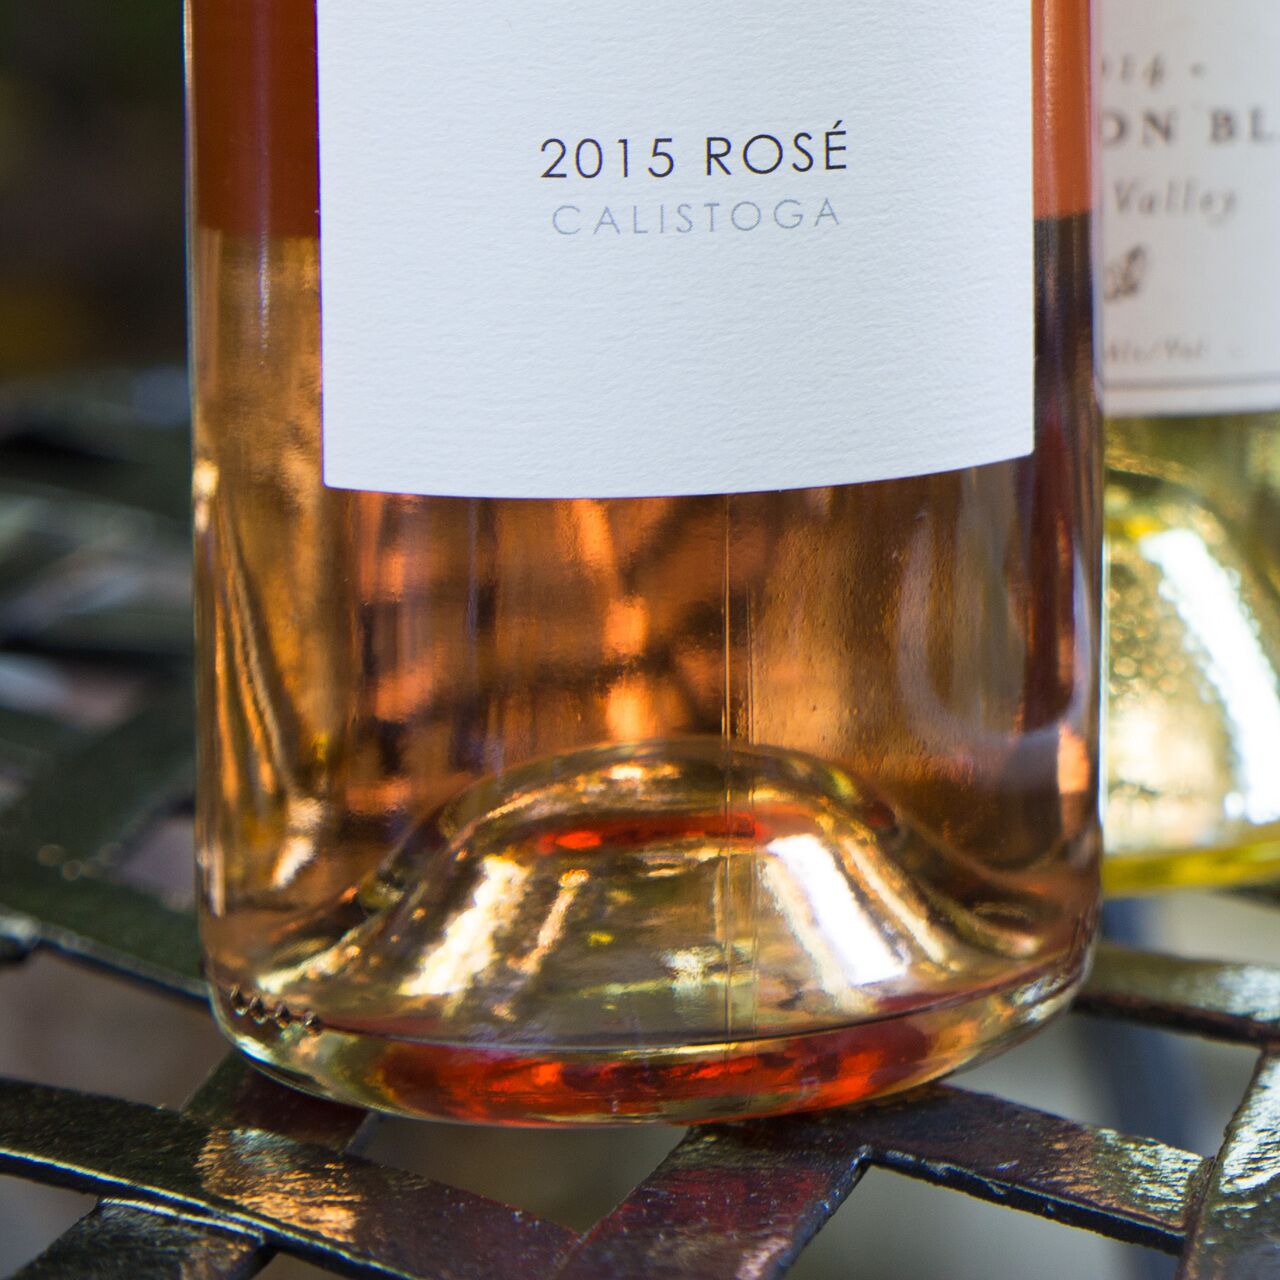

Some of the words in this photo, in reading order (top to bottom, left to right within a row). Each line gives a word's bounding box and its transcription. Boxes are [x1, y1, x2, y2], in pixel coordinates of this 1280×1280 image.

[540, 137, 676, 179] 2015
[706, 120, 848, 176] ROSÉ
[552, 197, 840, 237] CALISTOGA
[1113, 178, 1238, 226] Valley
